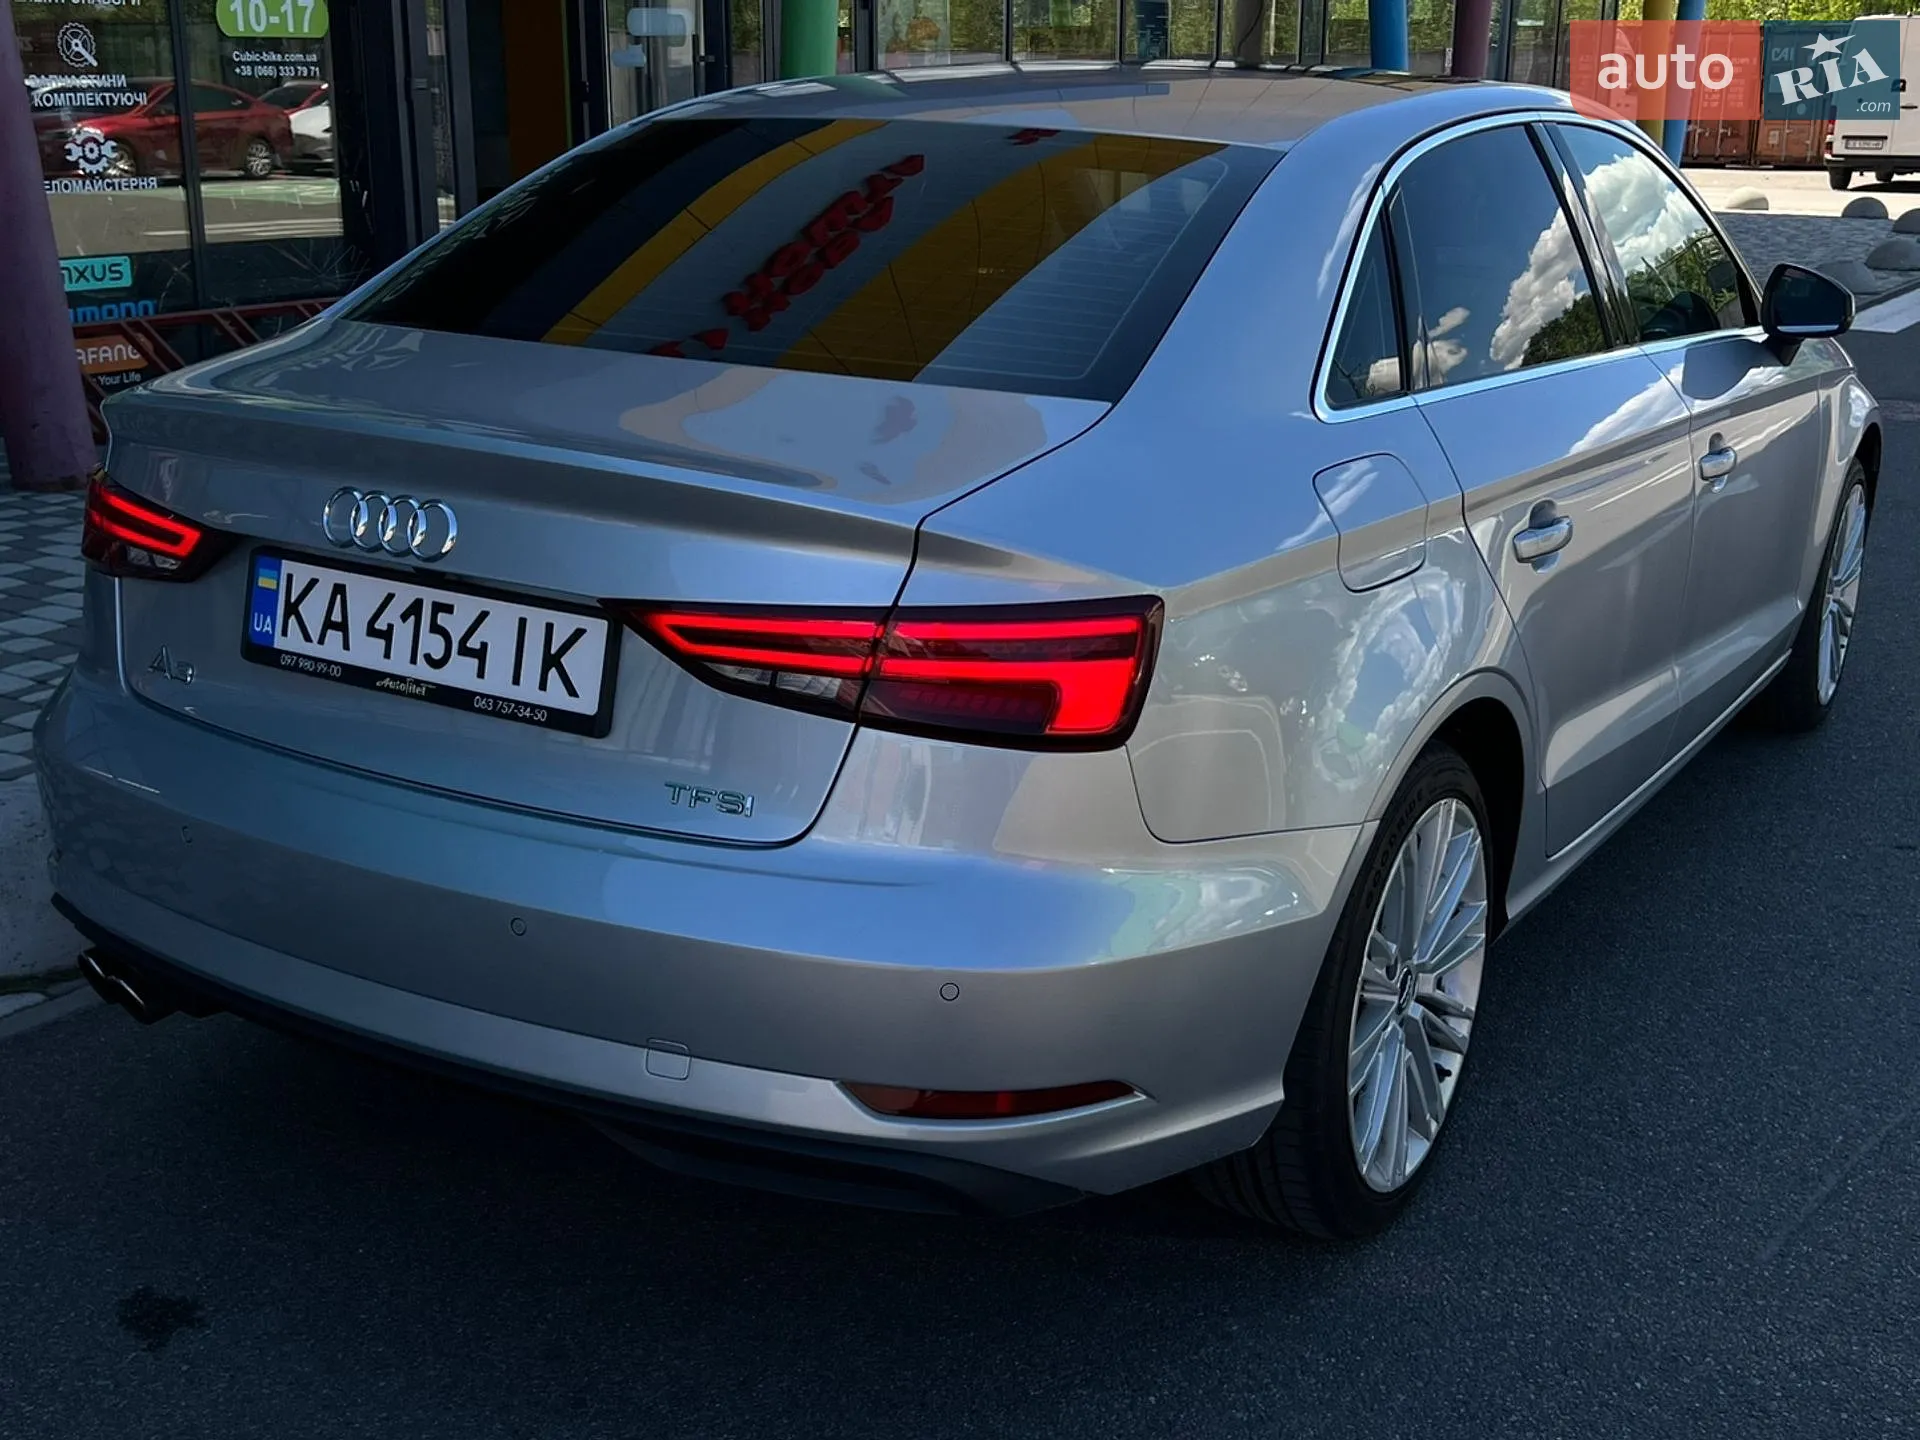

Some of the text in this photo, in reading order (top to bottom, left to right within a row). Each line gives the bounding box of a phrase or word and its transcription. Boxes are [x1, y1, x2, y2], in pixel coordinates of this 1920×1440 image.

[230, 0, 315, 33] 10-17
[232, 50, 318, 62] Cubic-bike.com.ua
[28, 73, 127, 88] ЗАПЧАСТИНИ
[234, 65, 320, 78] +38 (066) 333 79 71
[34, 91, 147, 108] КОМПЛЕКТУЮЧІ
[44, 176, 158, 194] ЕЛОМАЙСТЕРНЯ
[76, 343, 142, 366] AFANG
[98, 371, 142, 387] Your Life
[253, 612, 273, 635] UA
[280, 572, 588, 699] KA 4154 IK
[147, 645, 195, 685] A3
[473, 695, 548, 722] 063 757-34-50
[664, 781, 755, 818] TFSI
[1365, 787, 1425, 910] GOODRIDE
